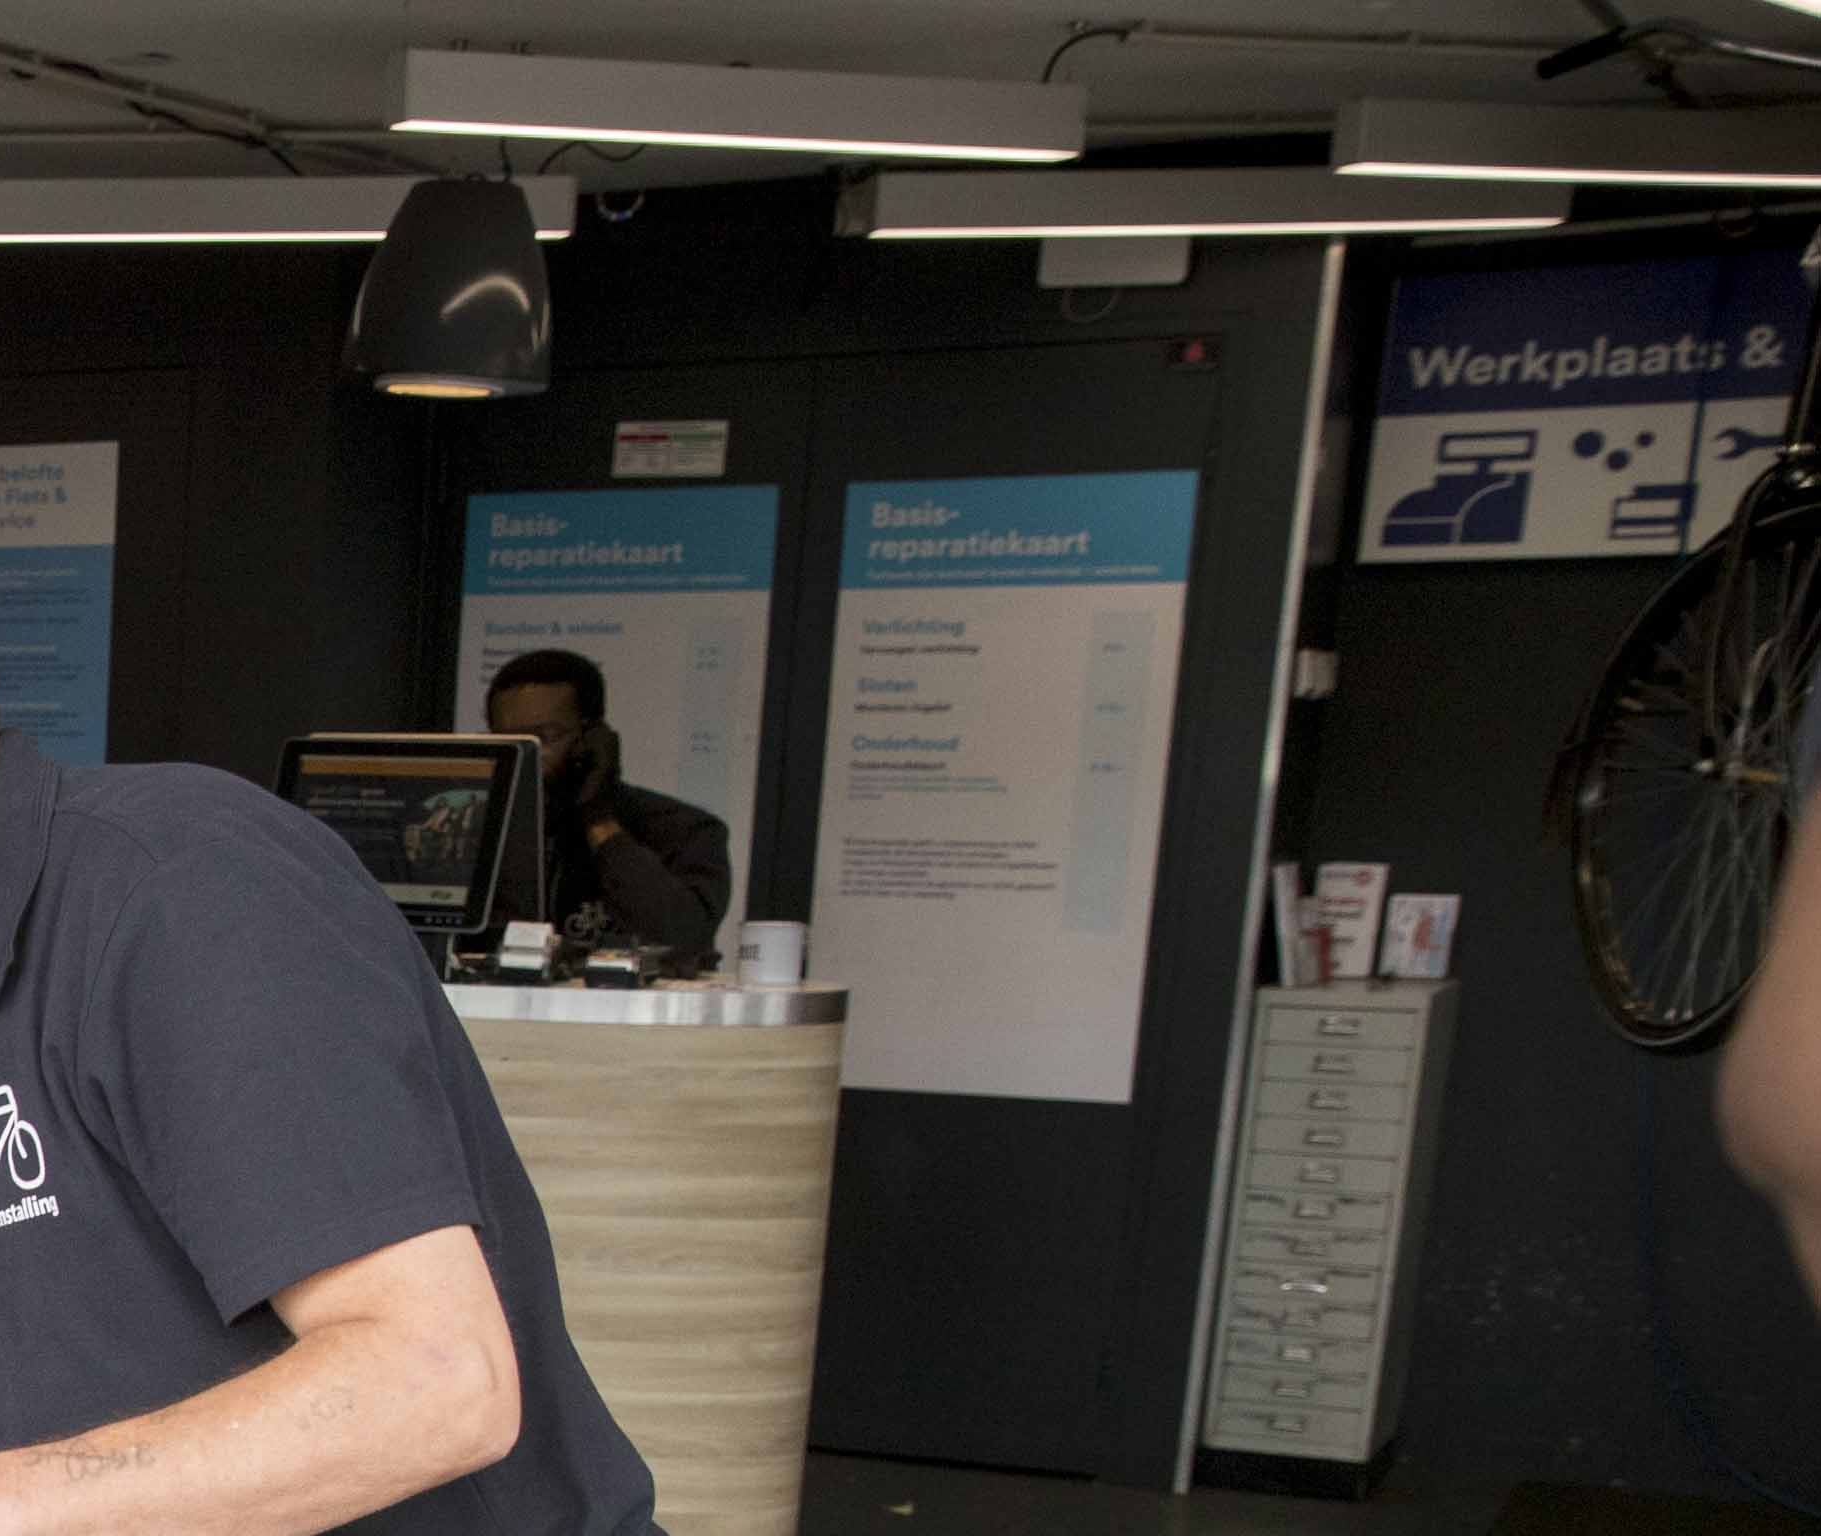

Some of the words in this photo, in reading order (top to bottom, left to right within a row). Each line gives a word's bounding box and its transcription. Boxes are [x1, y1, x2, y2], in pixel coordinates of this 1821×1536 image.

[1408, 335, 1726, 390] Werkplaats
[1741, 324, 1784, 369] &
[491, 512, 569, 538] Basis-
[871, 501, 961, 528] Basis-
[487, 540, 685, 571] reparatiekaart
[868, 530, 1092, 562] reparatiekaart
[862, 618, 966, 638] Verlichting
[852, 735, 961, 752] Onderhoud
